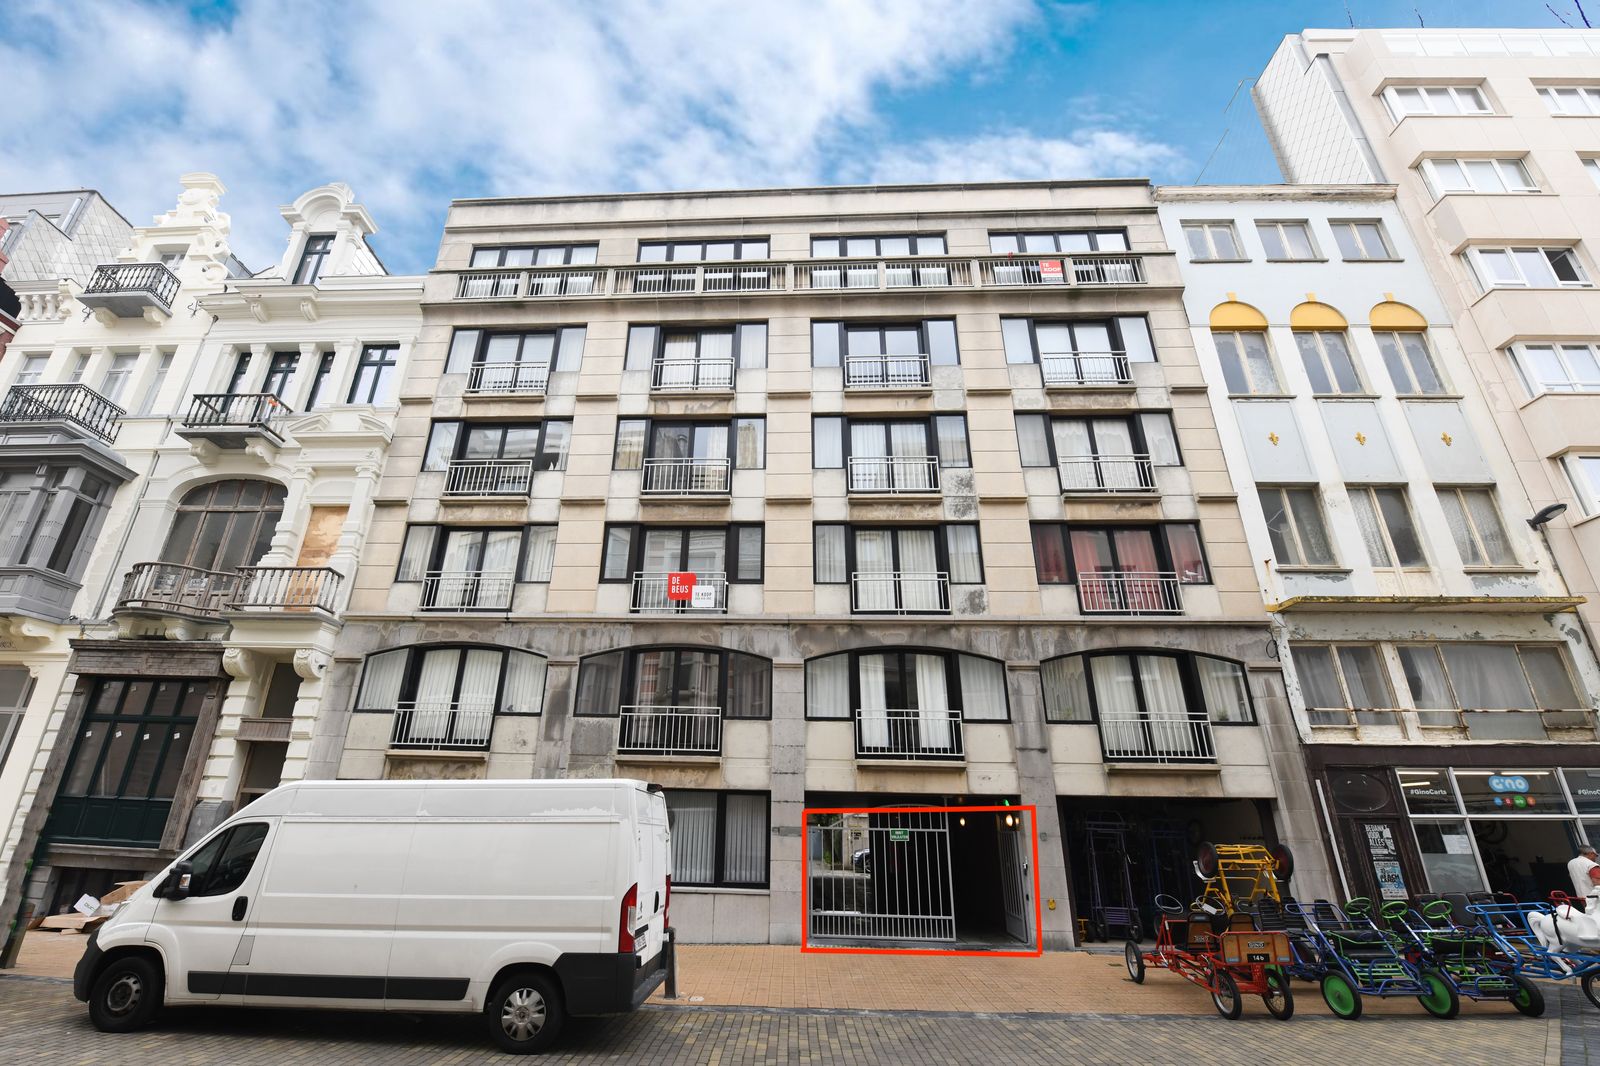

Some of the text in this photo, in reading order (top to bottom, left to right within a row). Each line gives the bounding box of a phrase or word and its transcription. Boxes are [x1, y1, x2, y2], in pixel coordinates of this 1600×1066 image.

[671, 576, 680, 585] DE
[671, 585, 689, 594] BEUS
[1369, 838, 1386, 847] ALLES
